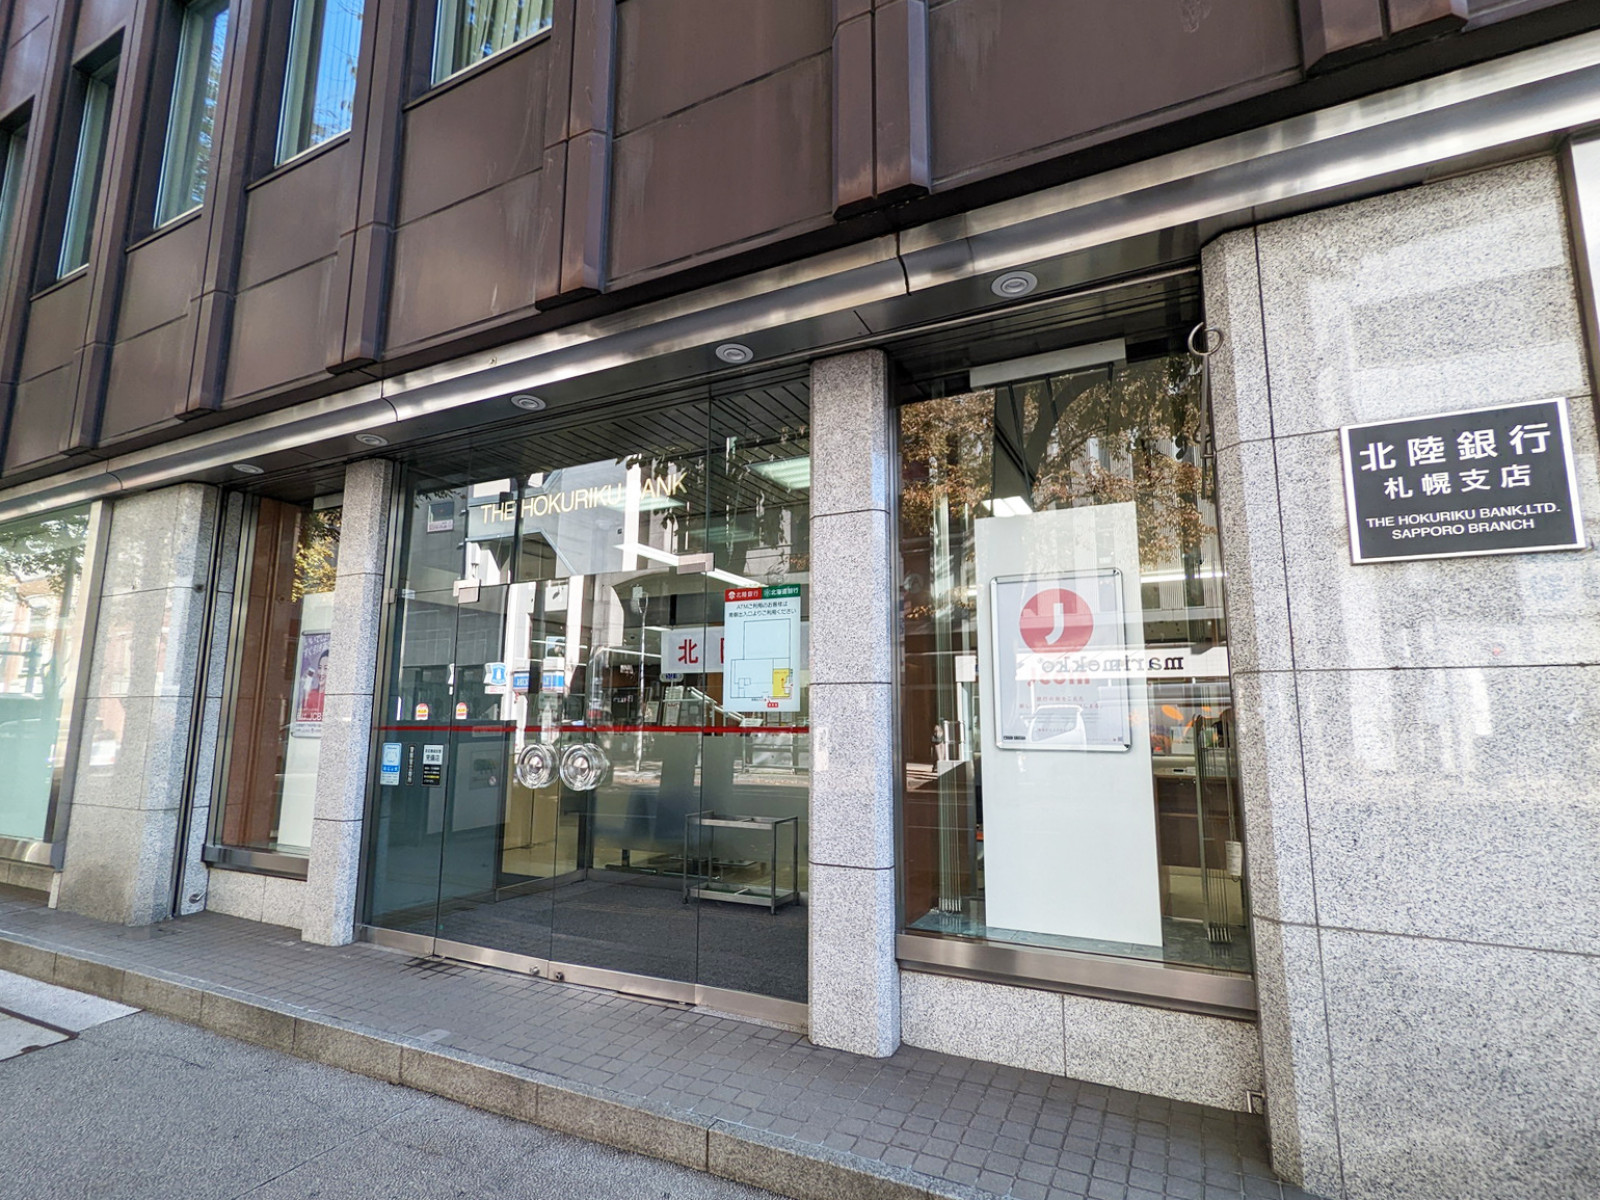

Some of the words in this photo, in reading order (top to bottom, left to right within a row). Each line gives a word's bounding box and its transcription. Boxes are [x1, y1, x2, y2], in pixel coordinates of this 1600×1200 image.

[1359, 422, 1551, 472] 北陸銀行
[1384, 464, 1531, 500] 札幌支店
[481, 500, 516, 524] THE
[520, 482, 623, 518] HOKURIKU
[1366, 516, 1395, 528] THE
[1398, 509, 1476, 526] HOKURIKU
[1391, 524, 1465, 540] SAPPORO
[1468, 518, 1535, 534] BRANCH
